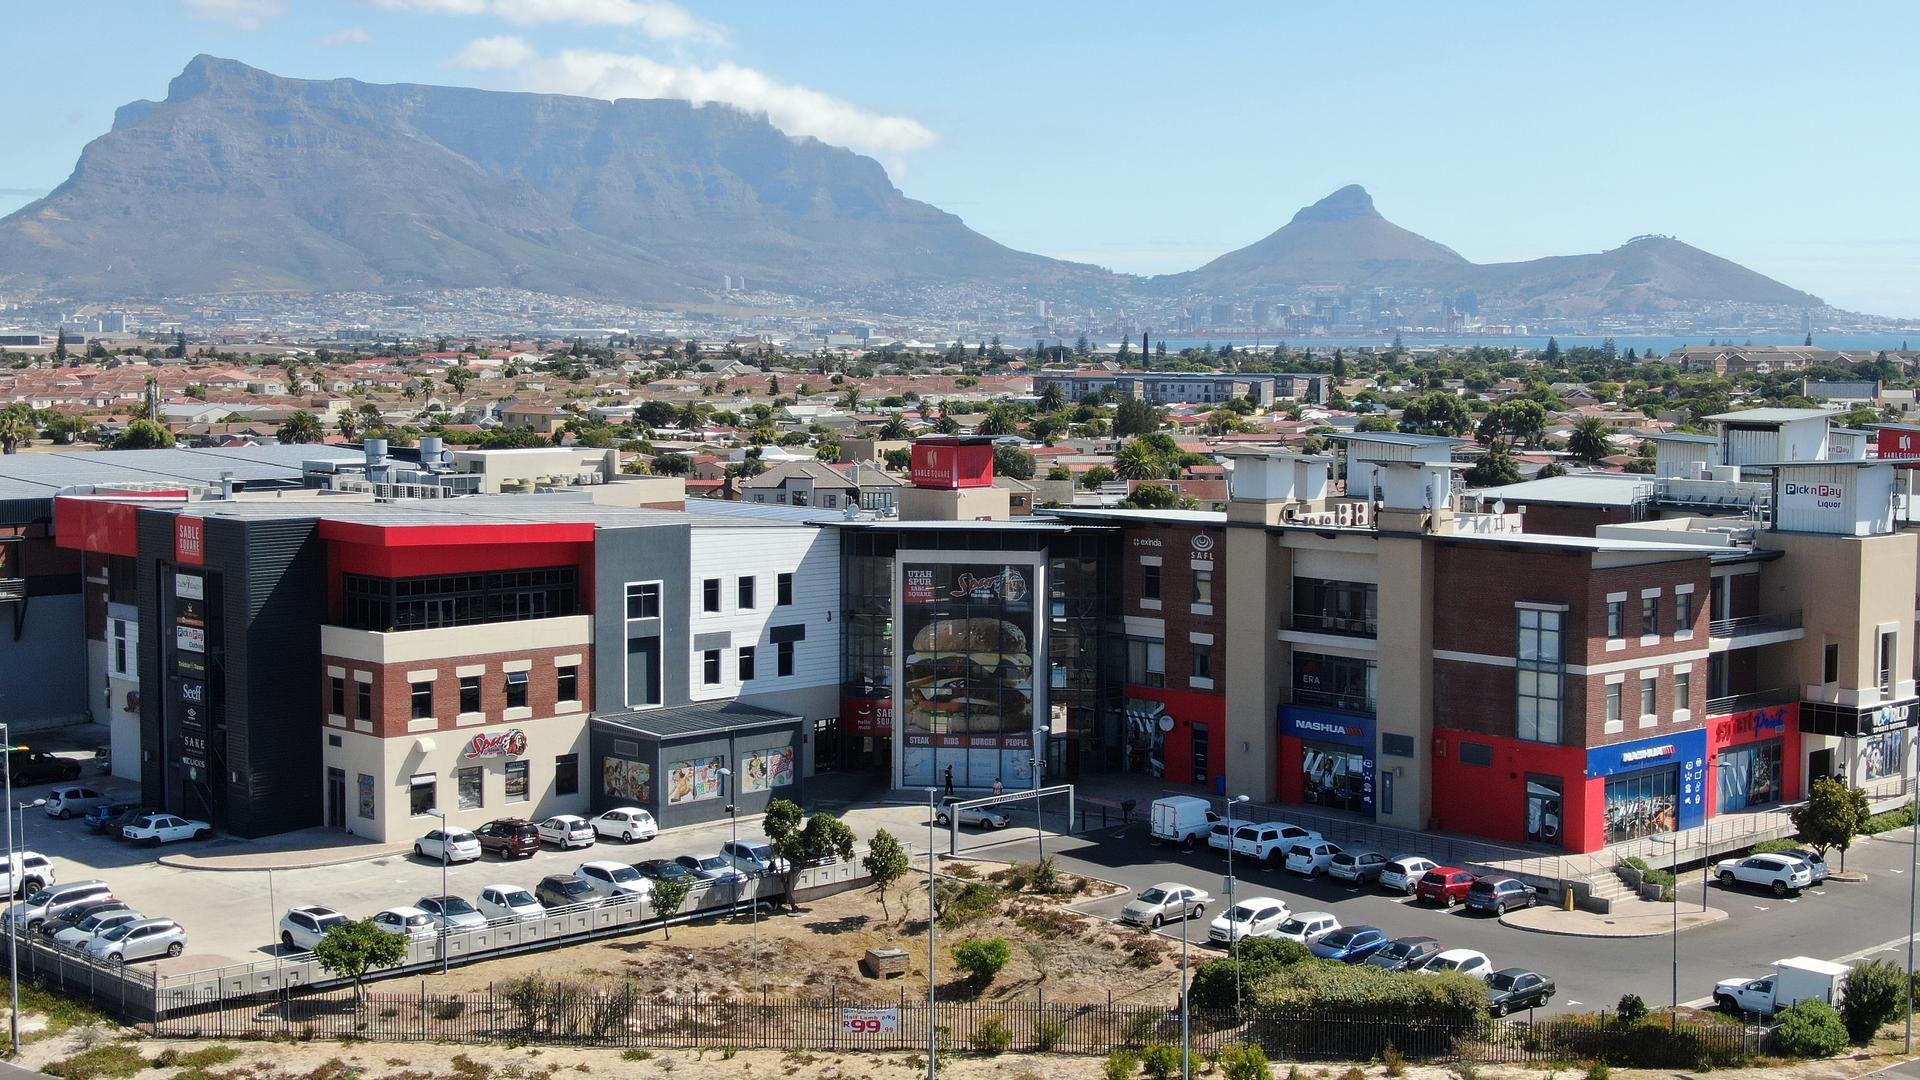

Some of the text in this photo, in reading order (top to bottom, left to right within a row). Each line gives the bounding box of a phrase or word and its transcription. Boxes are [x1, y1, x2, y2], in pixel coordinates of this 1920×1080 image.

[1785, 483, 1842, 498] Pick n Pay
[1817, 500, 1841, 508] Liquor
[179, 525, 200, 540] SABLE
[179, 538, 200, 551] SQUARE
[1140, 538, 1162, 546] exinda
[1191, 551, 1215, 560] SAFL
[907, 570, 933, 578] UTAH
[908, 578, 932, 586] SPUR
[1303, 674, 1320, 684] ERA
[183, 684, 202, 700] Seeff
[876, 708, 892, 717] SAB
[1872, 705, 1908, 726] WORLD
[1295, 719, 1346, 735] NASHUA
[184, 736, 205, 749] SAKE
[909, 736, 929, 745] STEAK
[943, 737, 960, 745] RIBS
[971, 738, 997, 746] BURGER
